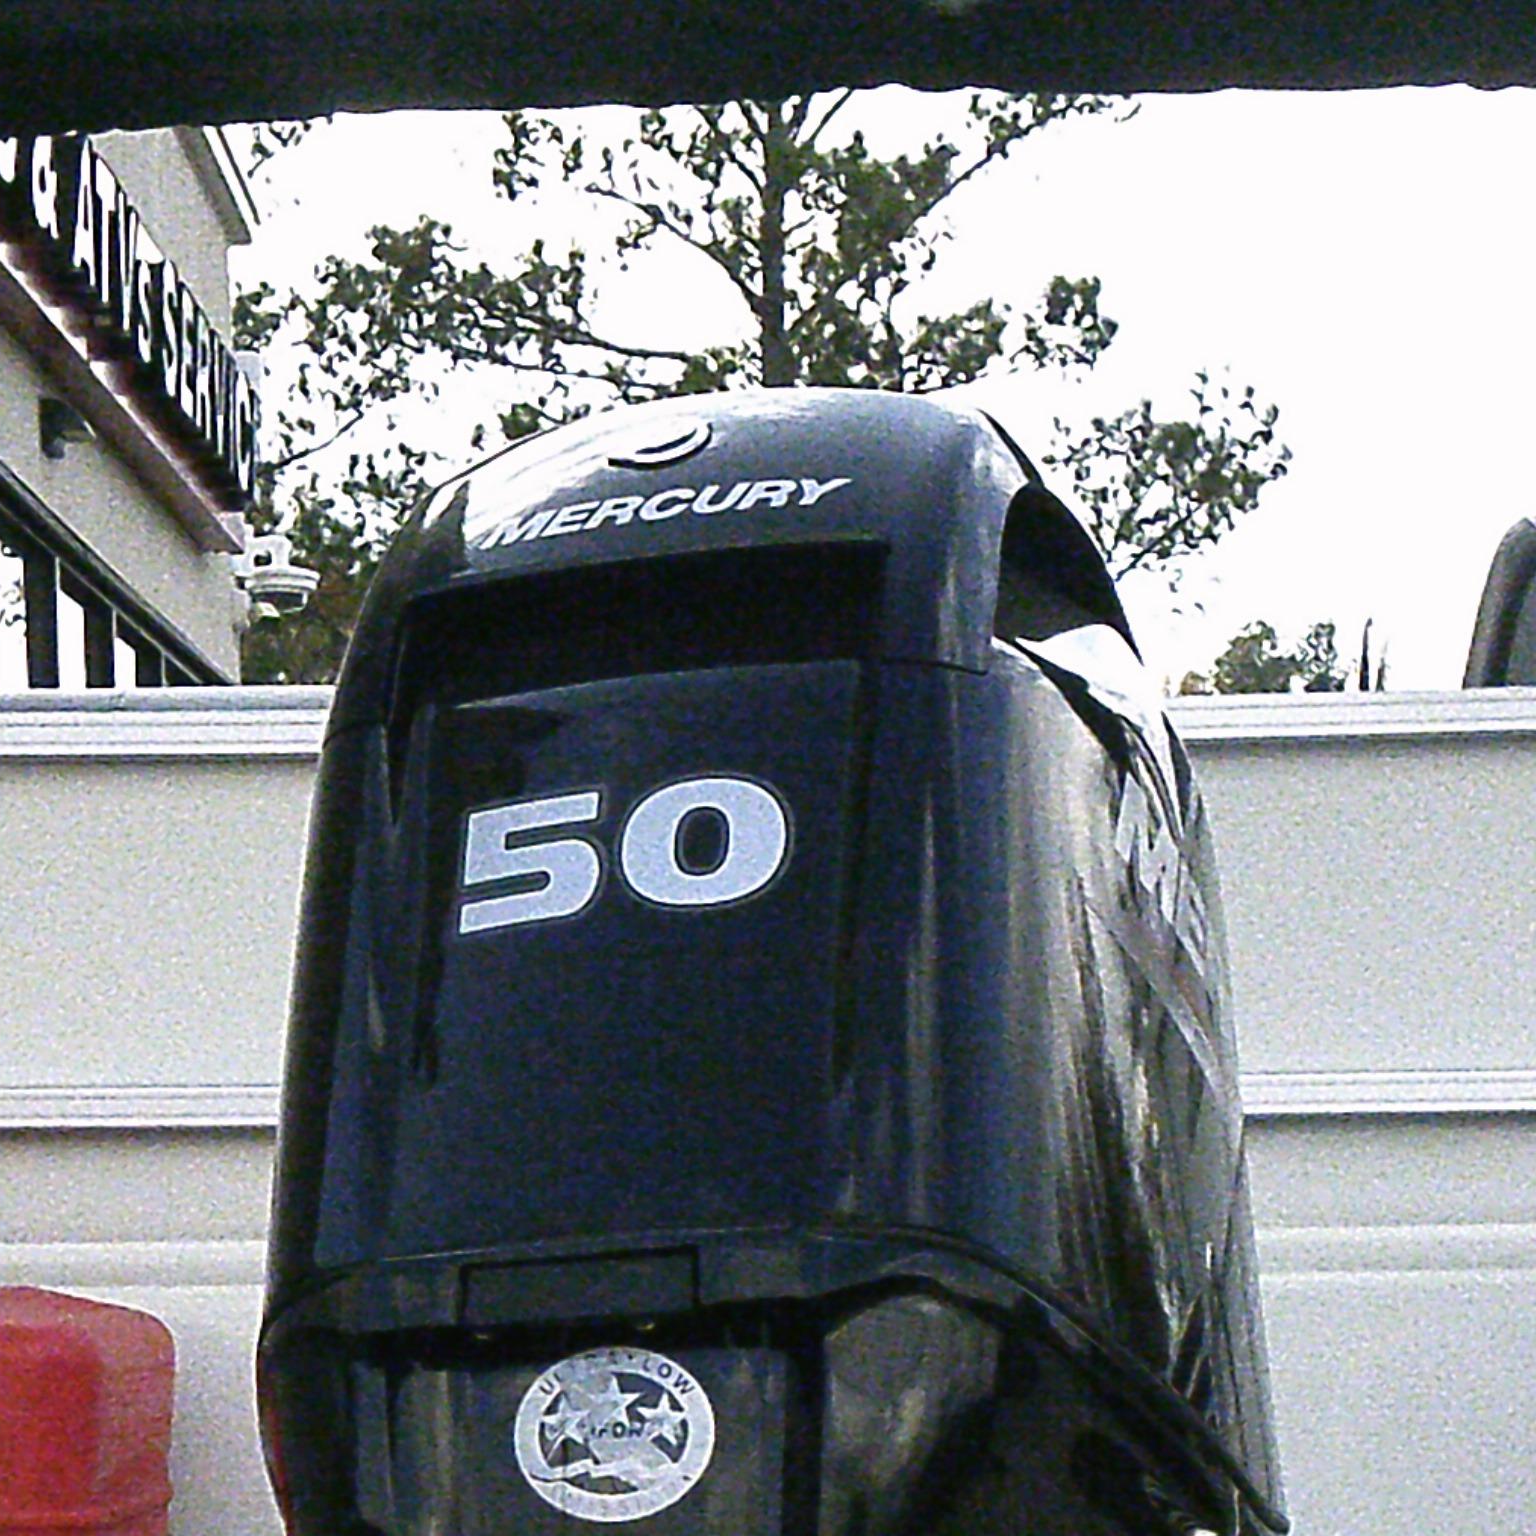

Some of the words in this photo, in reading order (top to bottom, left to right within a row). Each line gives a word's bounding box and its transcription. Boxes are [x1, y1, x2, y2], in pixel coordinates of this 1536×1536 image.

[474, 477, 853, 551] MERCURY
[459, 778, 787, 935] 50
[642, 1358, 695, 1395] LOW
